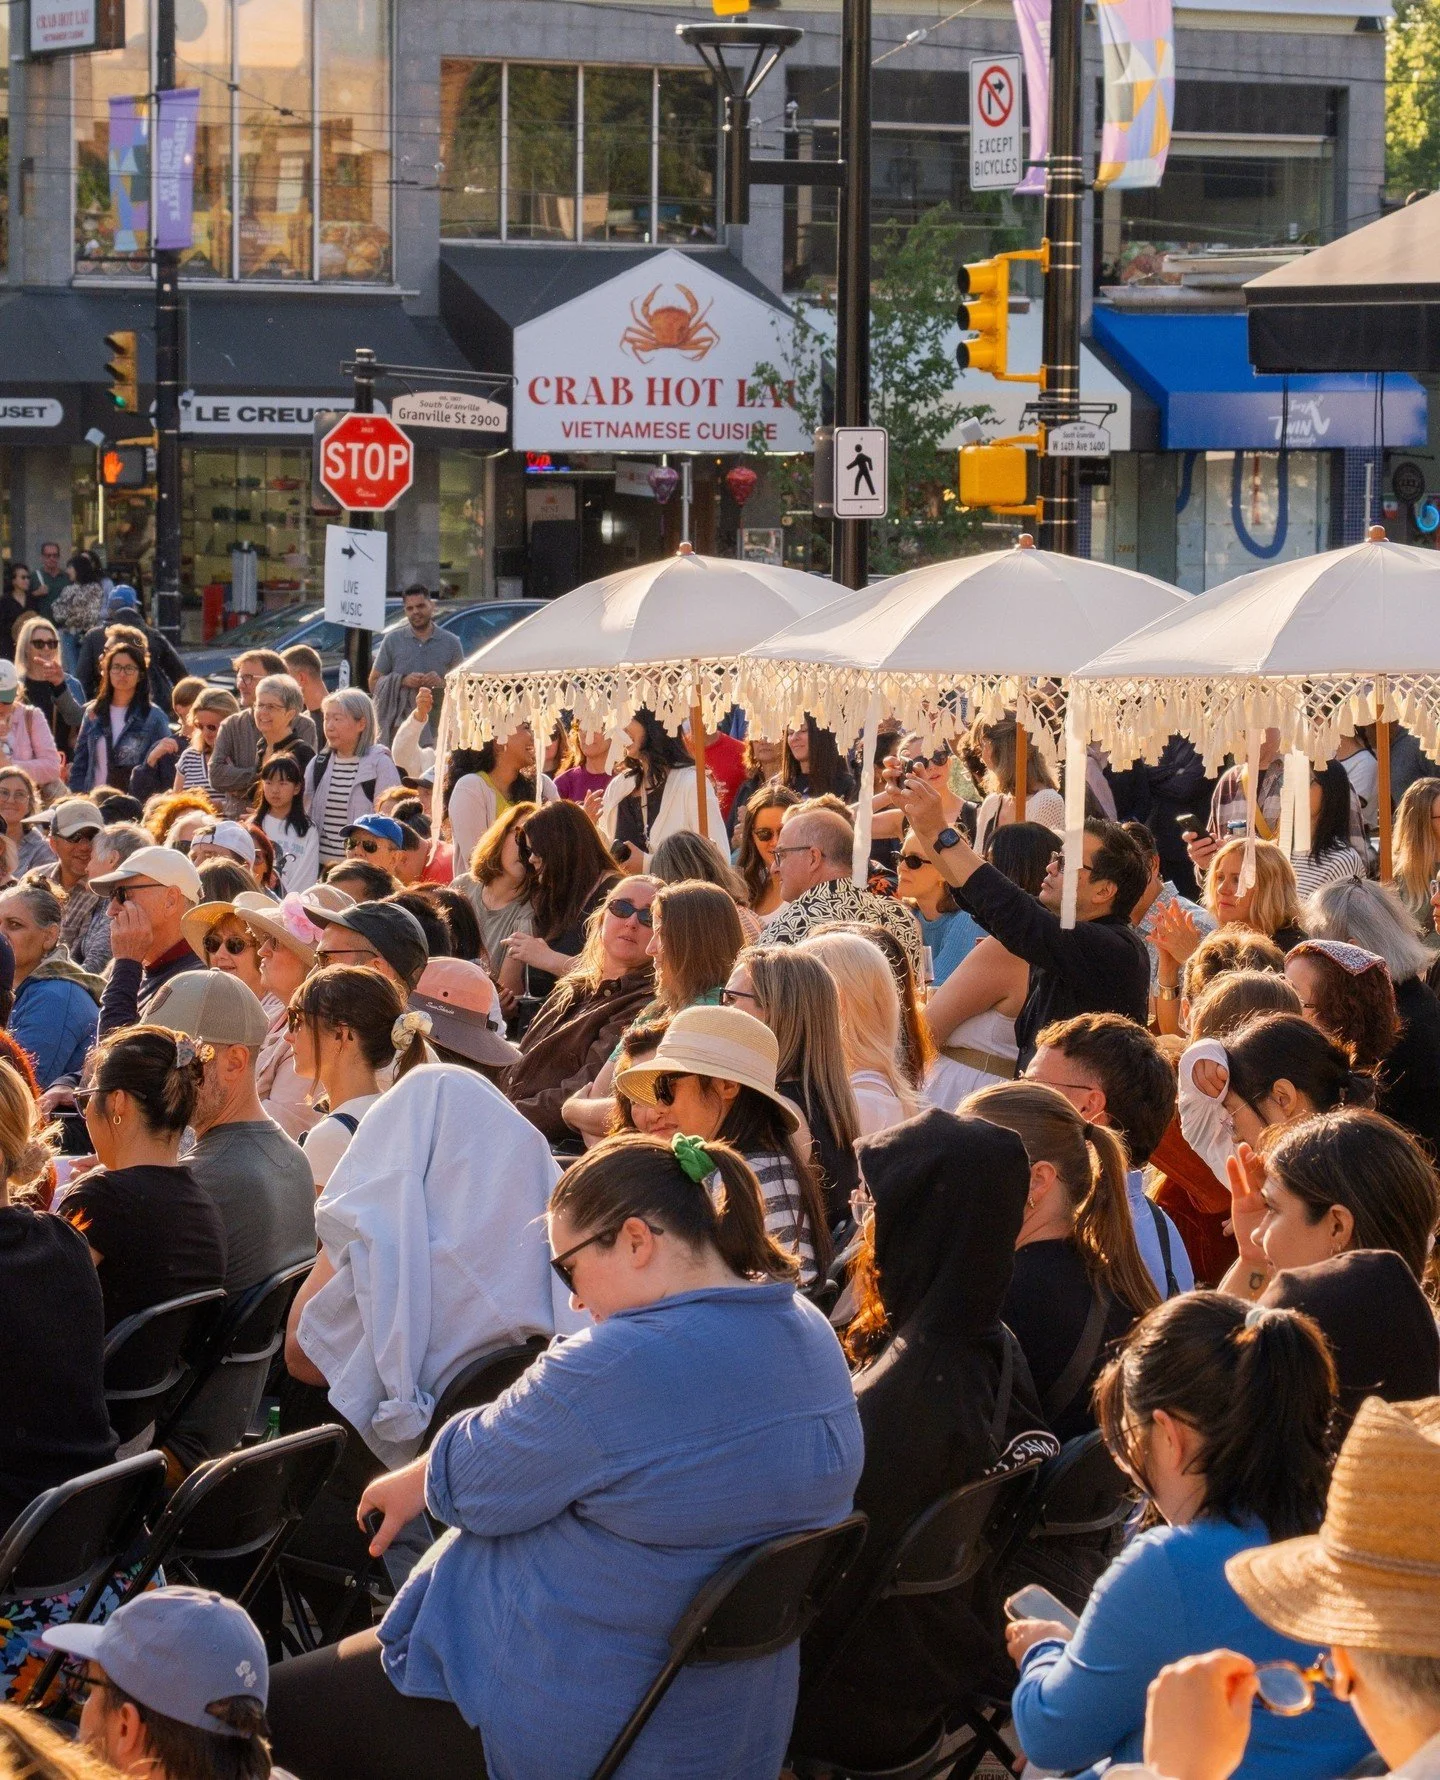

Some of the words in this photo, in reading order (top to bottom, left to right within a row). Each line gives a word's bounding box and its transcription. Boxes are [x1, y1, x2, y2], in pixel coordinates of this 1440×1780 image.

[979, 136, 1012, 154] EXCEPT
[974, 157, 1018, 176] BICYCLES
[528, 375, 634, 406] CRAB
[645, 376, 724, 407] HOT
[0, 405, 47, 418] SET
[419, 399, 442, 408] South
[444, 401, 480, 412] Granville
[195, 406, 231, 422] LE
[236, 406, 355, 423] CREU
[398, 407, 451, 423] Granville
[454, 411, 467, 424] St
[470, 414, 500, 427] 2900
[561, 421, 691, 439] VIETNAMESE
[1076, 440, 1088, 451] Ave
[325, 441, 409, 481] STOP
[342, 579, 360, 595] LIVE
[340, 600, 363, 617] MUSIC
